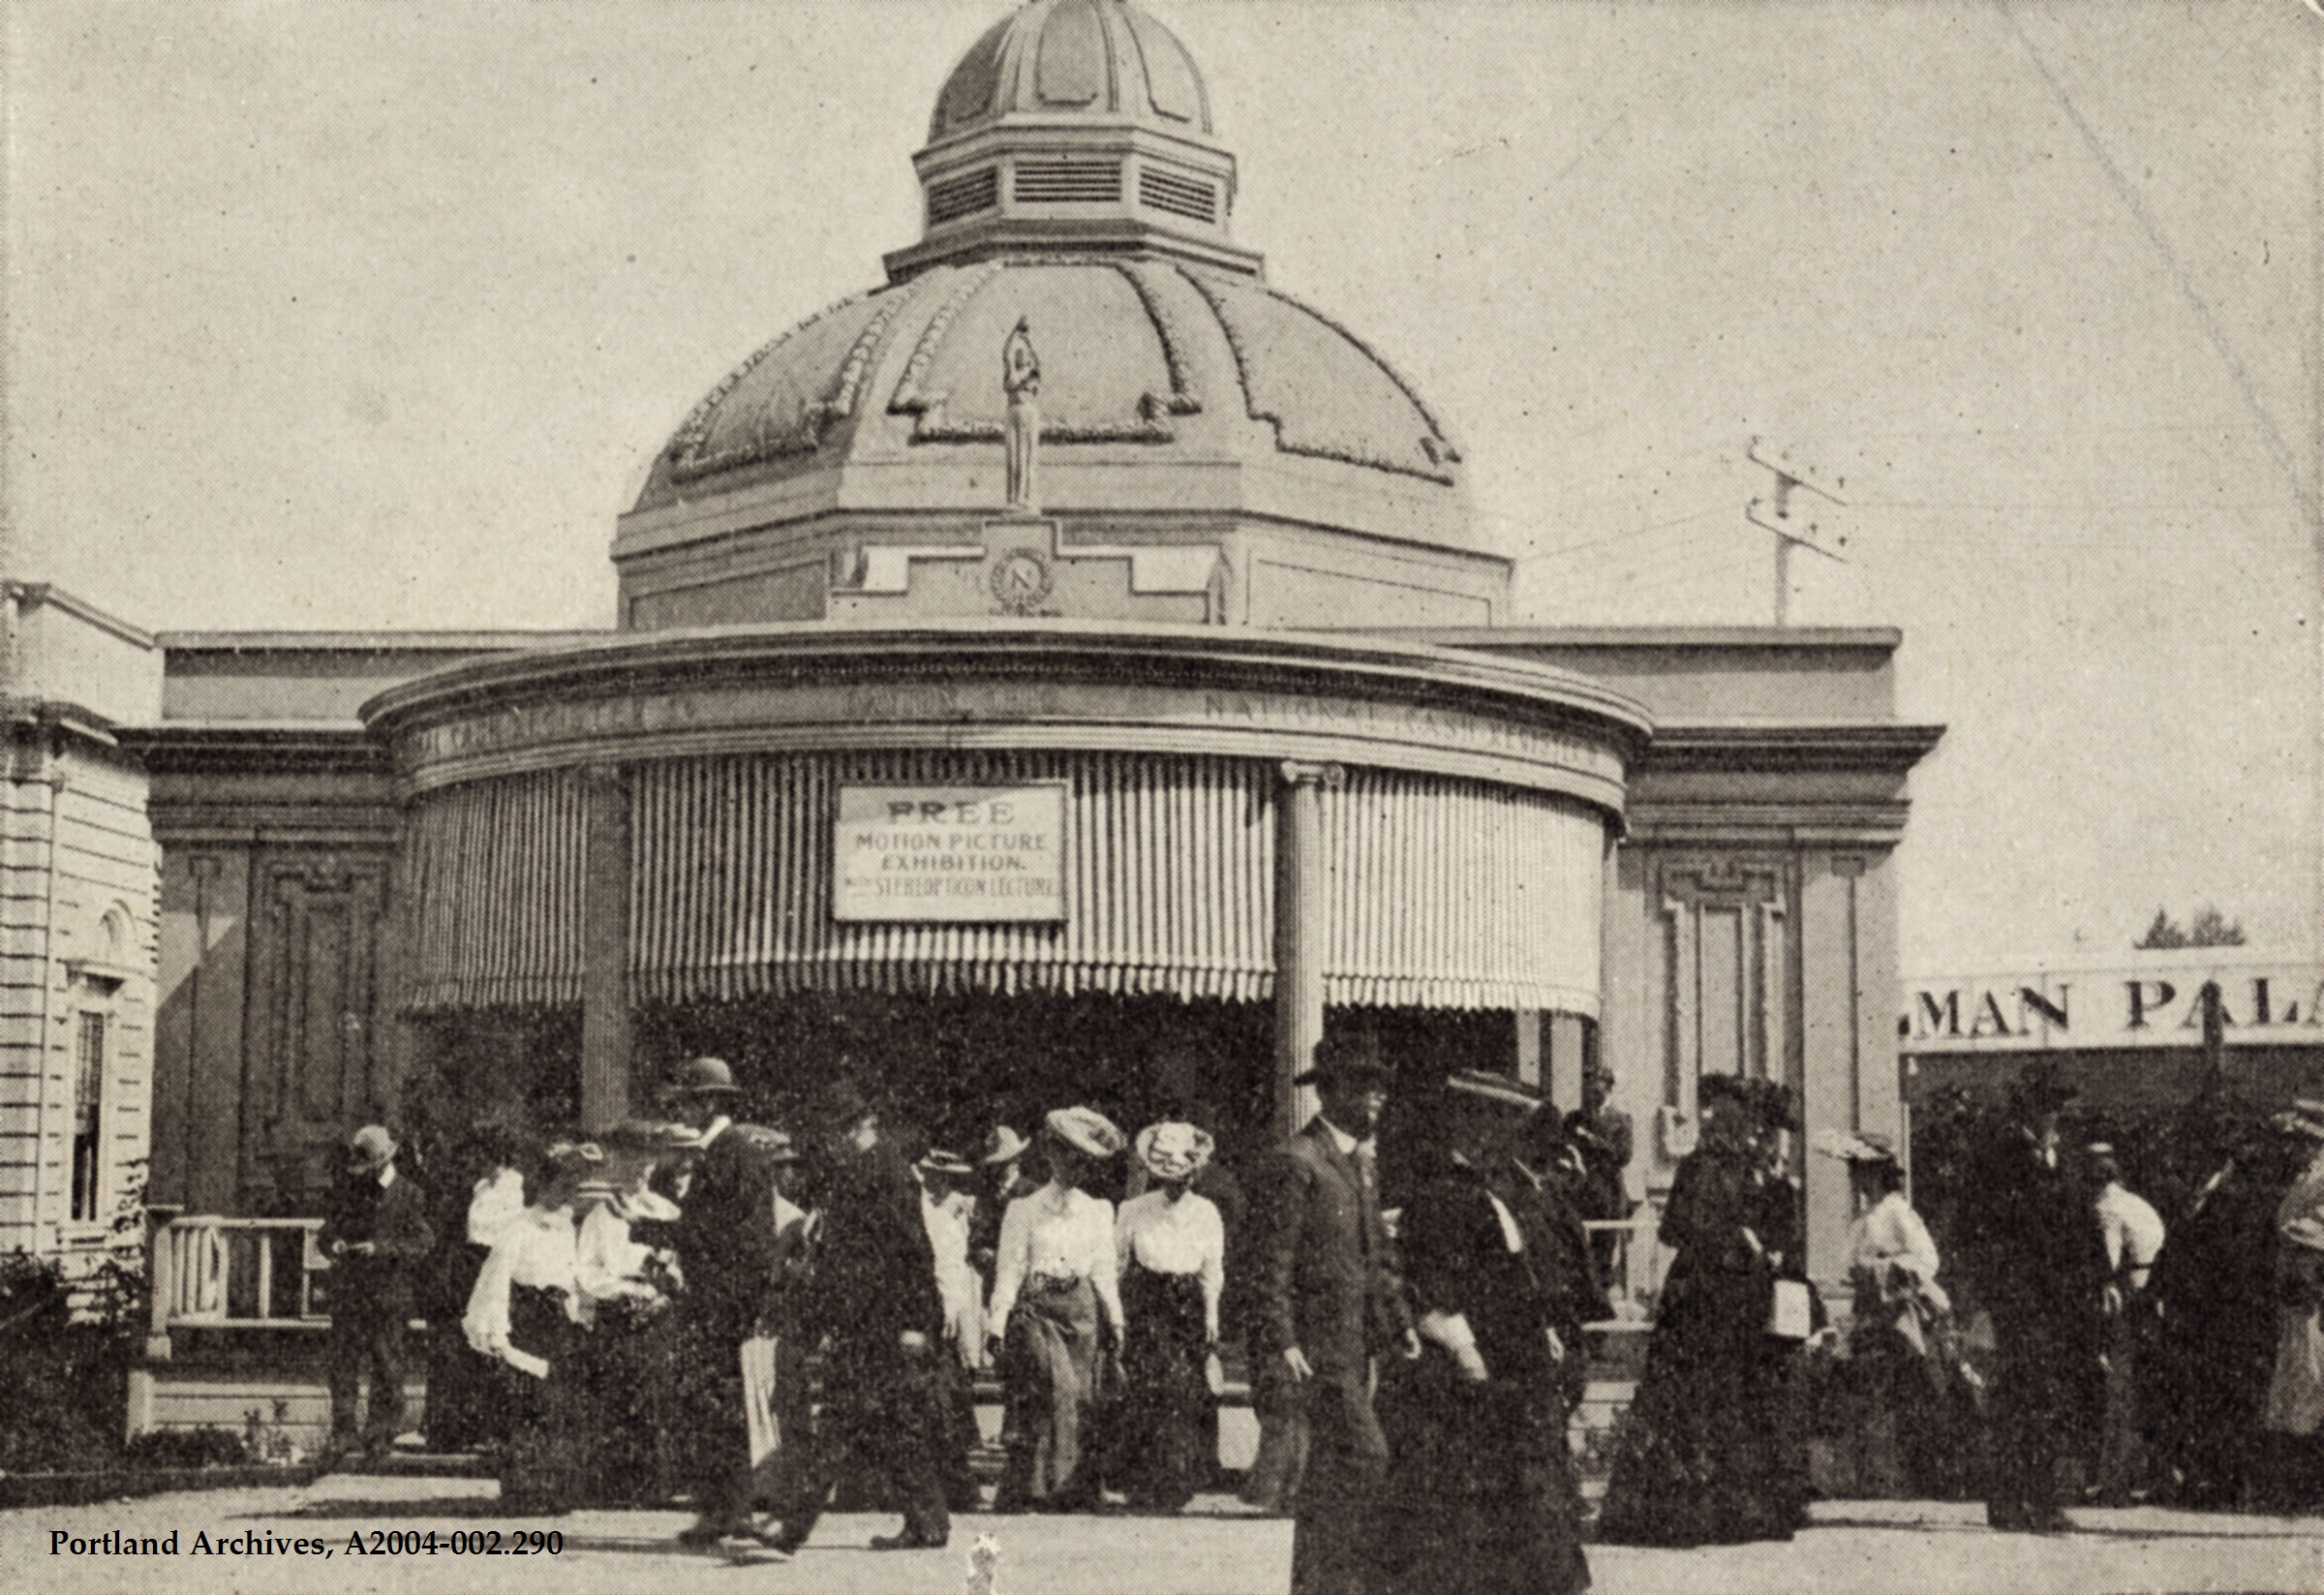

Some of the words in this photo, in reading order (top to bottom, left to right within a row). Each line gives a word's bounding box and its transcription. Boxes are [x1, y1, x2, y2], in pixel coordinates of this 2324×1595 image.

[887, 801, 1015, 823] FREE
[854, 833, 941, 850] MOTION
[948, 833, 1048, 850] PICTURE
[1898, 983, 2070, 1040] MAN
